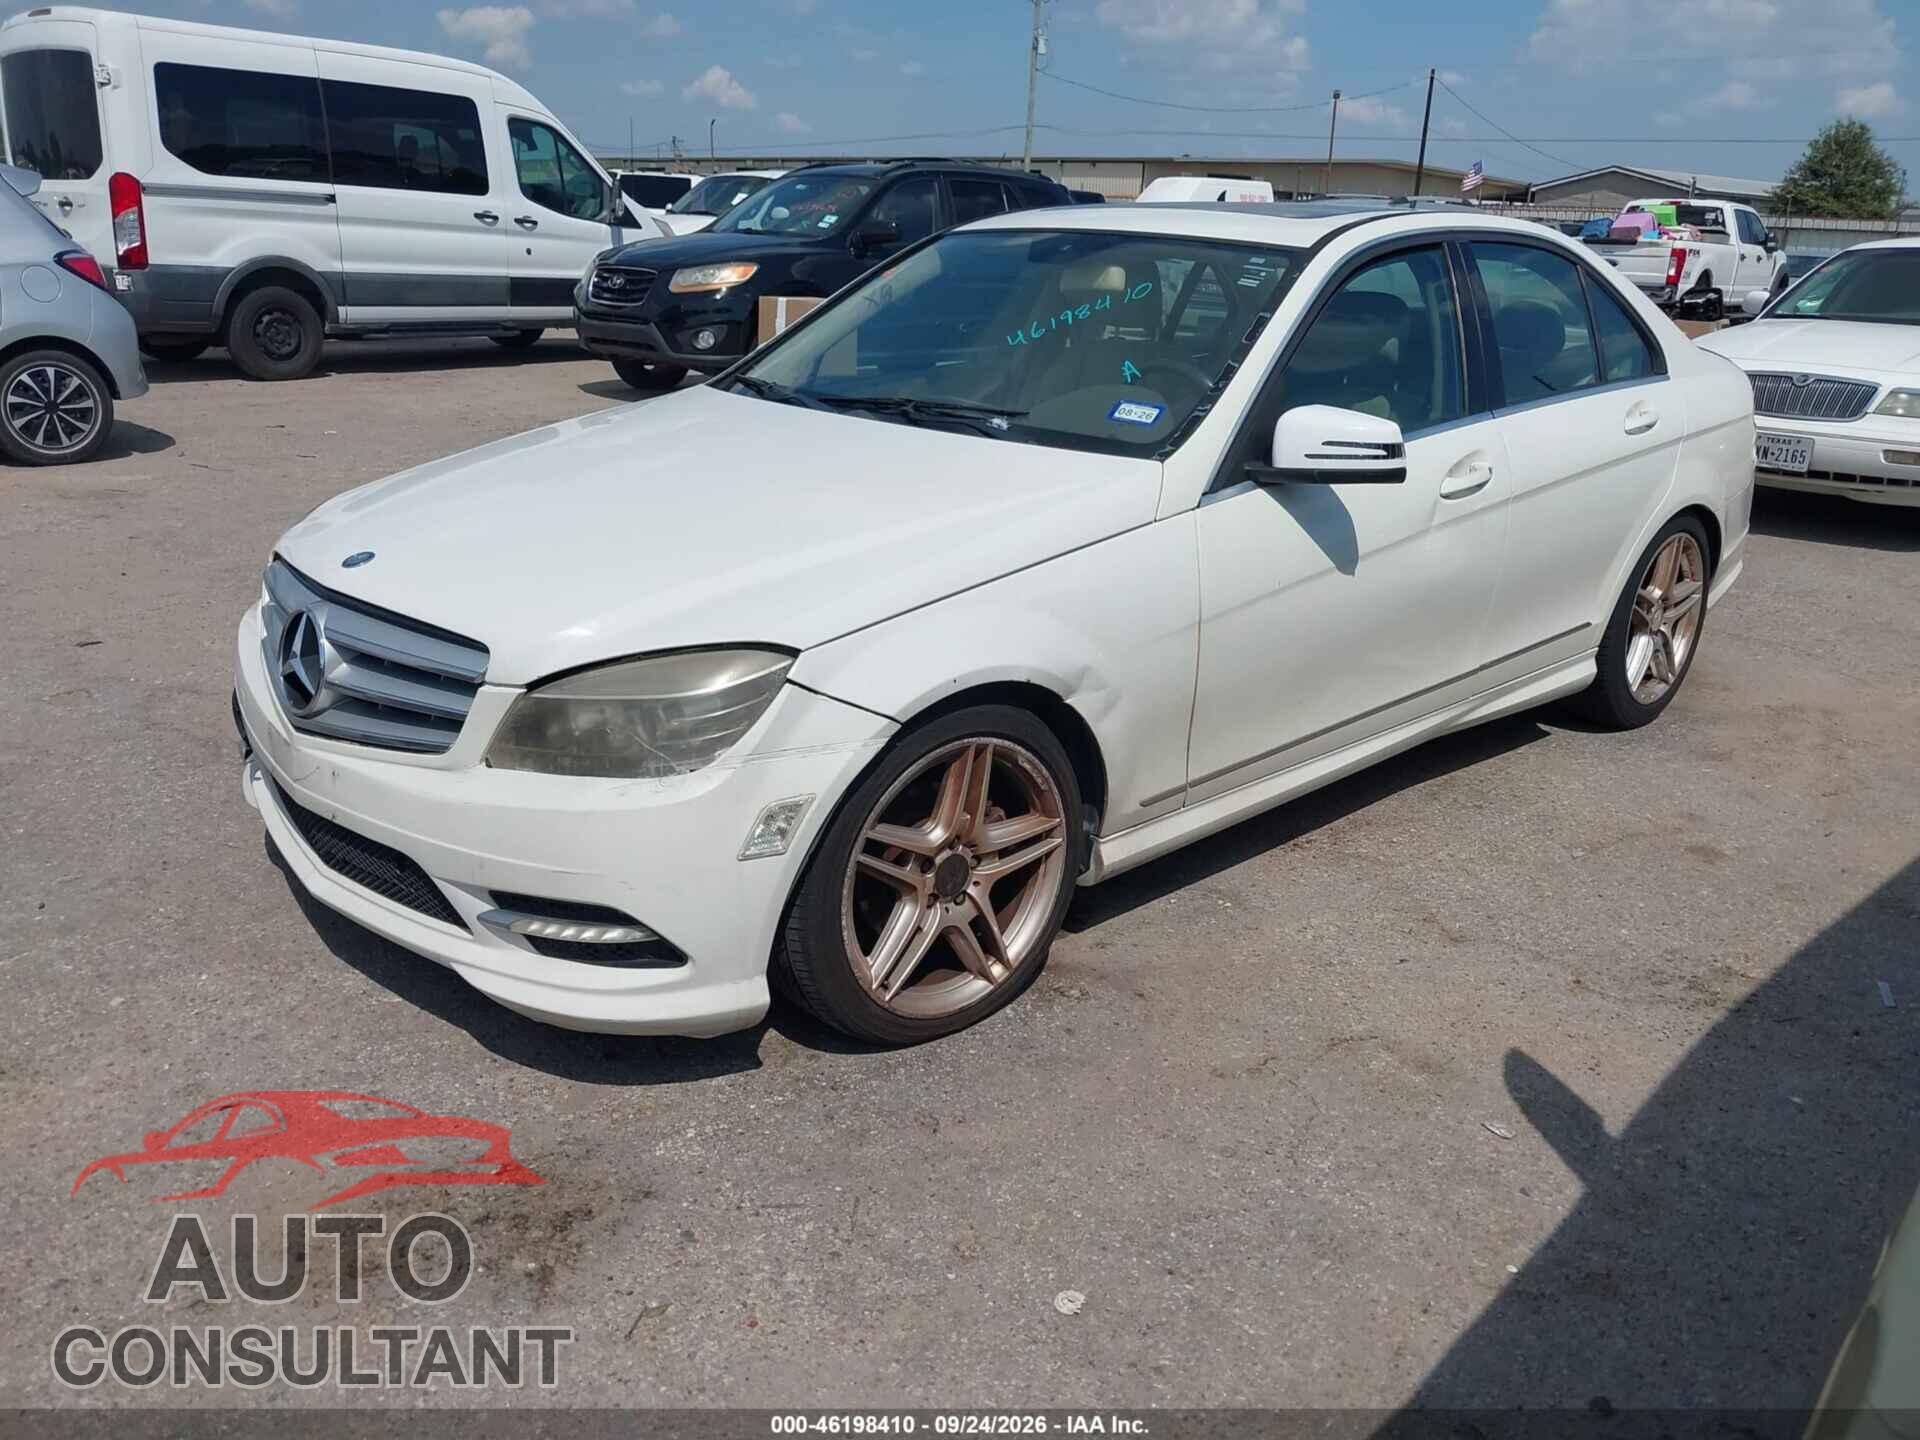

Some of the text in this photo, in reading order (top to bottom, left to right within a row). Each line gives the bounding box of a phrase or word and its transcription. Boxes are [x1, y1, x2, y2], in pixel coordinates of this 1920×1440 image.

[1007, 282, 1152, 346] 46198410
[1121, 360, 1142, 383] A
[1767, 437, 1792, 446] TEXAS
